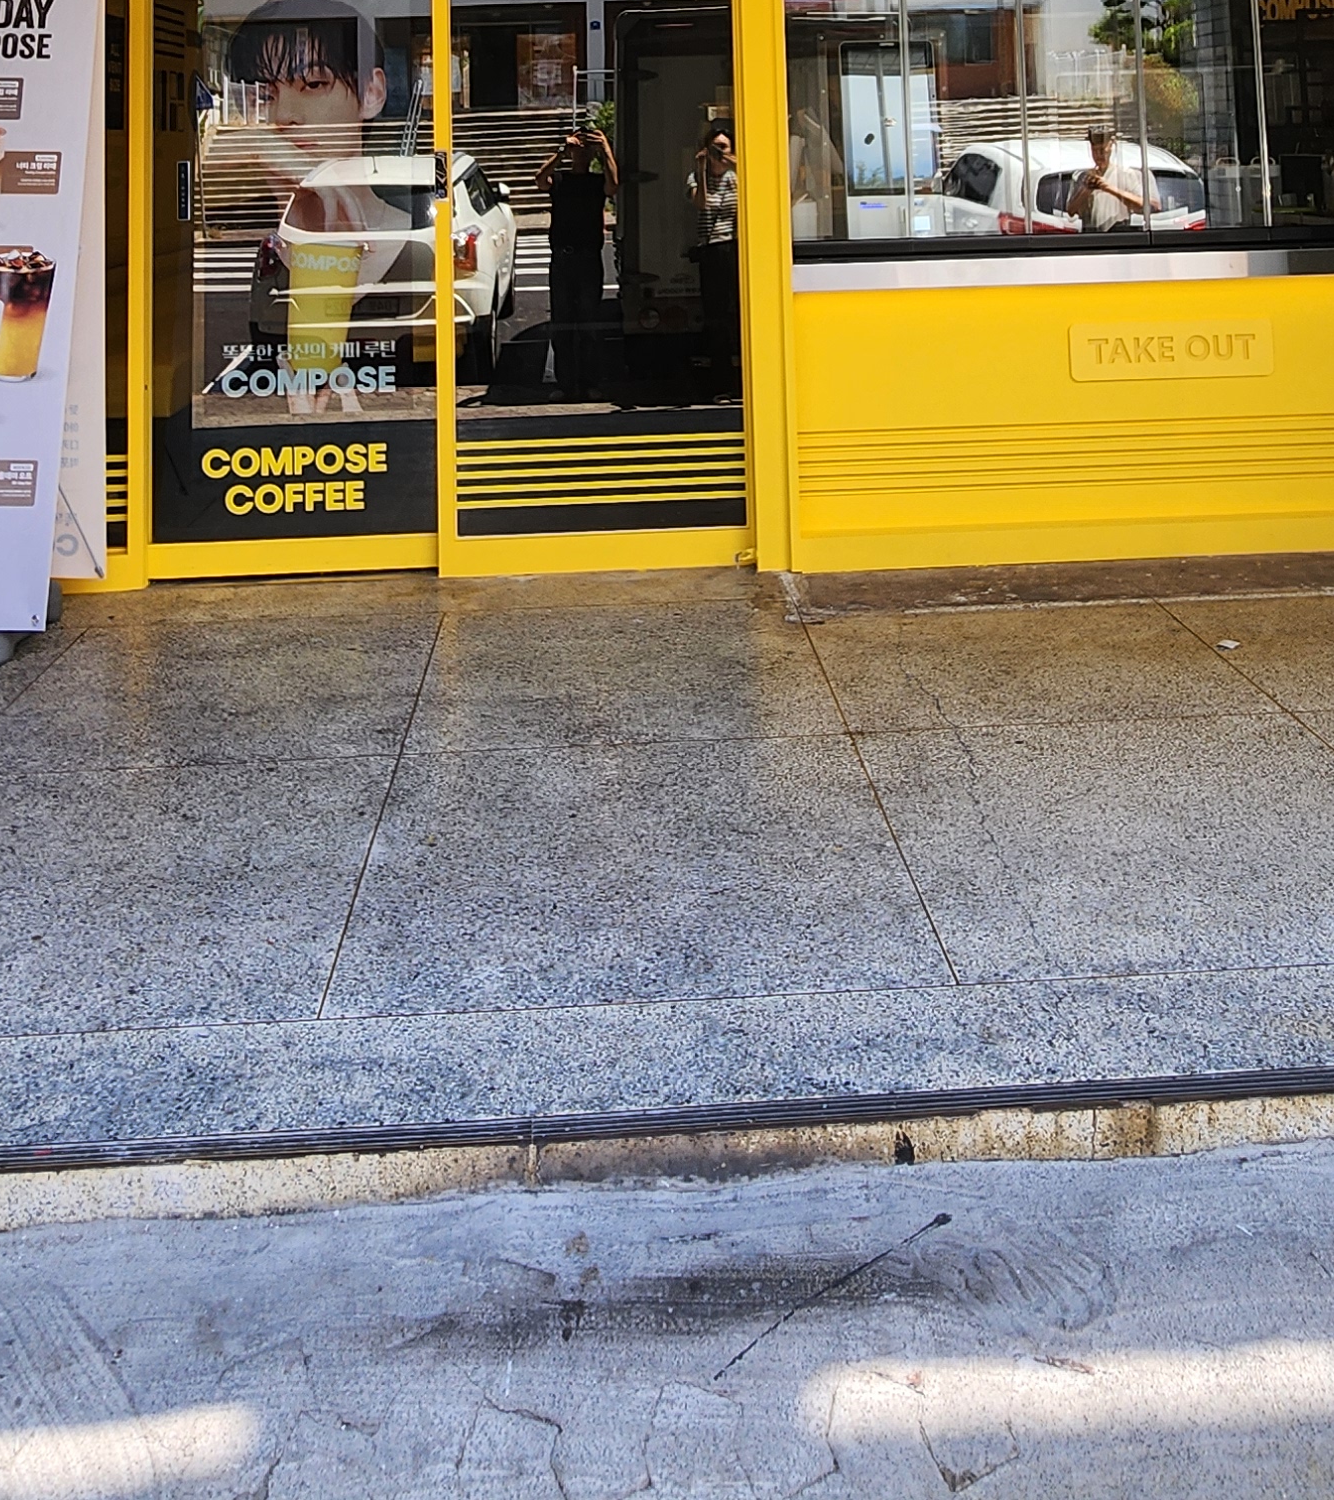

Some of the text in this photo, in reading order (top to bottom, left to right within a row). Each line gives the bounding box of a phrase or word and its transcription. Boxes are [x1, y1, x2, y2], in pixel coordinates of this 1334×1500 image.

[277, 343, 326, 360] 당신의
[329, 342, 360, 358] 커피
[364, 340, 397, 357] 루틴
[1087, 333, 1256, 364] TAKE OUT
[221, 366, 397, 398] COMPOSE
[201, 443, 388, 479] COMPOSE
[225, 481, 365, 515] COFFEE
